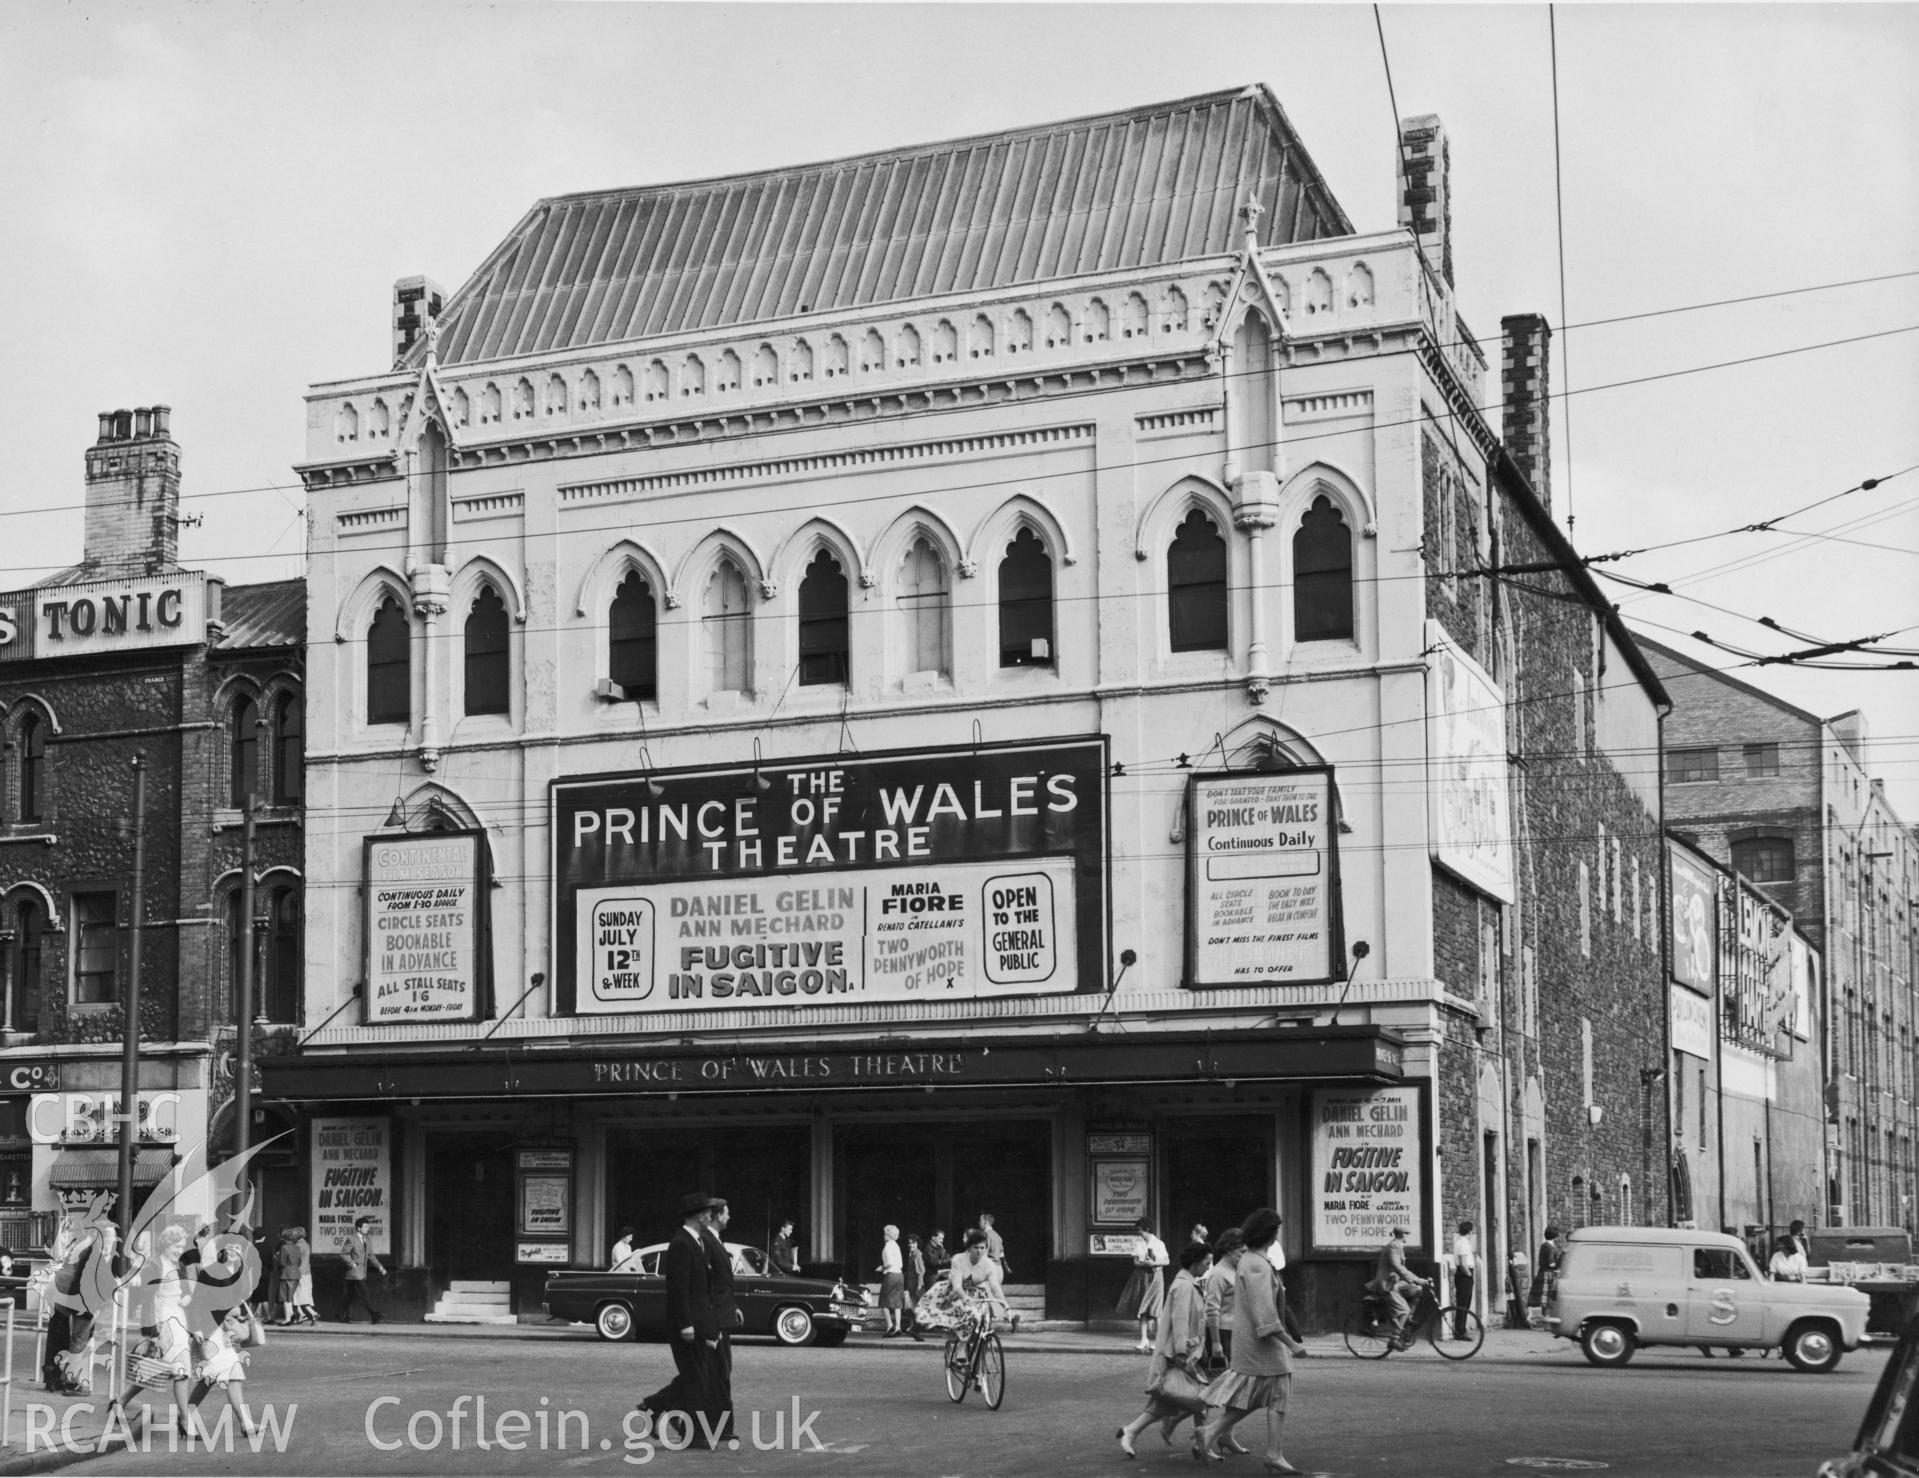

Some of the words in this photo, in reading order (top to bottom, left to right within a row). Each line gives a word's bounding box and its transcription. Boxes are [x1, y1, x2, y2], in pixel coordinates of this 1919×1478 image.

[43, 589, 182, 640] TONIC
[787, 771, 844, 794] THE
[1230, 796, 1259, 804] GRANTED
[574, 798, 759, 848] PRINCE
[791, 797, 841, 825] OF
[879, 774, 1078, 825] WALES
[1208, 807, 1254, 828] PRINCE
[1258, 810, 1268, 821] OF
[1271, 804, 1318, 824] WALES
[703, 826, 931, 871] THEATRE
[1208, 836, 1273, 850] Continuous
[1279, 831, 1315, 848] Daily
[379, 846, 468, 867] CONTINENTAL
[383, 870, 409, 880] FILM
[417, 865, 463, 879] SEASON
[378, 891, 434, 902] CONTINUOUS
[436, 888, 465, 898] DAILY
[892, 882, 940, 896] MARIA
[1211, 892, 1223, 900] ALL
[1226, 889, 1253, 899] CIRCLE
[1269, 889, 1290, 899] BOOK
[388, 901, 411, 910] FROM
[671, 894, 764, 918] DANIEL
[776, 887, 853, 912] GELIN
[882, 895, 963, 914] FIORE
[992, 887, 1037, 909] OPEN
[1220, 900, 1241, 908] SEATS
[1269, 901, 1280, 910] THE
[1281, 899, 1296, 909] EASY
[1299, 898, 1315, 906] WAY
[599, 912, 642, 926] SUNDAY
[993, 912, 1009, 925] TO
[1015, 909, 1039, 923] THE
[1213, 907, 1253, 918] BOOKABLE
[1222, 916, 1254, 926] ADVANCE
[1268, 912, 1285, 922] RELAX
[378, 915, 421, 930] CIRCLE
[425, 914, 464, 926] SEATS
[679, 920, 721, 937] ANN
[731, 913, 844, 936] MECHARD
[877, 923, 904, 931] RENATO
[908, 919, 964, 930] CATELLANI'S
[386, 932, 452, 951] BOOKABLE
[599, 929, 637, 946] JULY
[993, 930, 1045, 951] GENERAL
[1268, 934, 1294, 942] FINEST
[1297, 932, 1318, 940] FILMS
[878, 938, 909, 955] TWO
[381, 954, 394, 970] IN
[399, 951, 456, 970] ADVANCE
[681, 941, 843, 971] FUGITIVE
[874, 940, 964, 973] PENNYWORTH
[1000, 952, 1039, 970] PUBLIC
[905, 972, 921, 990] OF
[927, 961, 964, 984] HOPE
[1268, 965, 1293, 973] OFFER
[378, 982, 399, 999] ALL
[404, 977, 434, 990] STALL
[437, 978, 465, 992] SEATS
[669, 974, 702, 999] IN
[711, 968, 847, 997] SAIGON
[947, 977, 954, 988] X
[380, 1006, 401, 1015] BEFORE
[420, 1004, 442, 1012] MONDAY
[446, 1003, 463, 1011] FRIDAY
[595, 1062, 682, 1082] PRINCE
[701, 1060, 732, 1079] OF
[748, 1057, 830, 1080] WALES
[850, 1054, 961, 1075] THEATRE
[1323, 1105, 1364, 1122] DANIEL
[1370, 1105, 1408, 1121] GELIN
[319, 1133, 349, 1147] DANIEL
[354, 1132, 382, 1145] GELIN
[1328, 1125, 1350, 1138] ANN
[1357, 1125, 1403, 1137] MECHARD
[323, 1148, 339, 1160] ANN
[344, 1148, 378, 1160] MECHARD
[1331, 1147, 1403, 1168] FUGITIVE
[324, 1168, 378, 1187] FUGITIVE
[1324, 1171, 1342, 1193] IN
[1345, 1171, 1408, 1192] SAIGON
[319, 1189, 333, 1208] IN
[334, 1188, 383, 1207] SAIGON
[1324, 1201, 1345, 1210] MARIA
[1349, 1200, 1369, 1210] FIORE
[319, 1215, 336, 1224] MARIA
[338, 1215, 353, 1223] FIORE
[1325, 1214, 1347, 1224] TWO
[1351, 1214, 1410, 1224] PENNYWORTH
[320, 1227, 336, 1235] TWO
[1344, 1227, 1358, 1236] OF
[1361, 1227, 1387, 1236] HOPE
[1710, 1287, 1738, 1326] S
